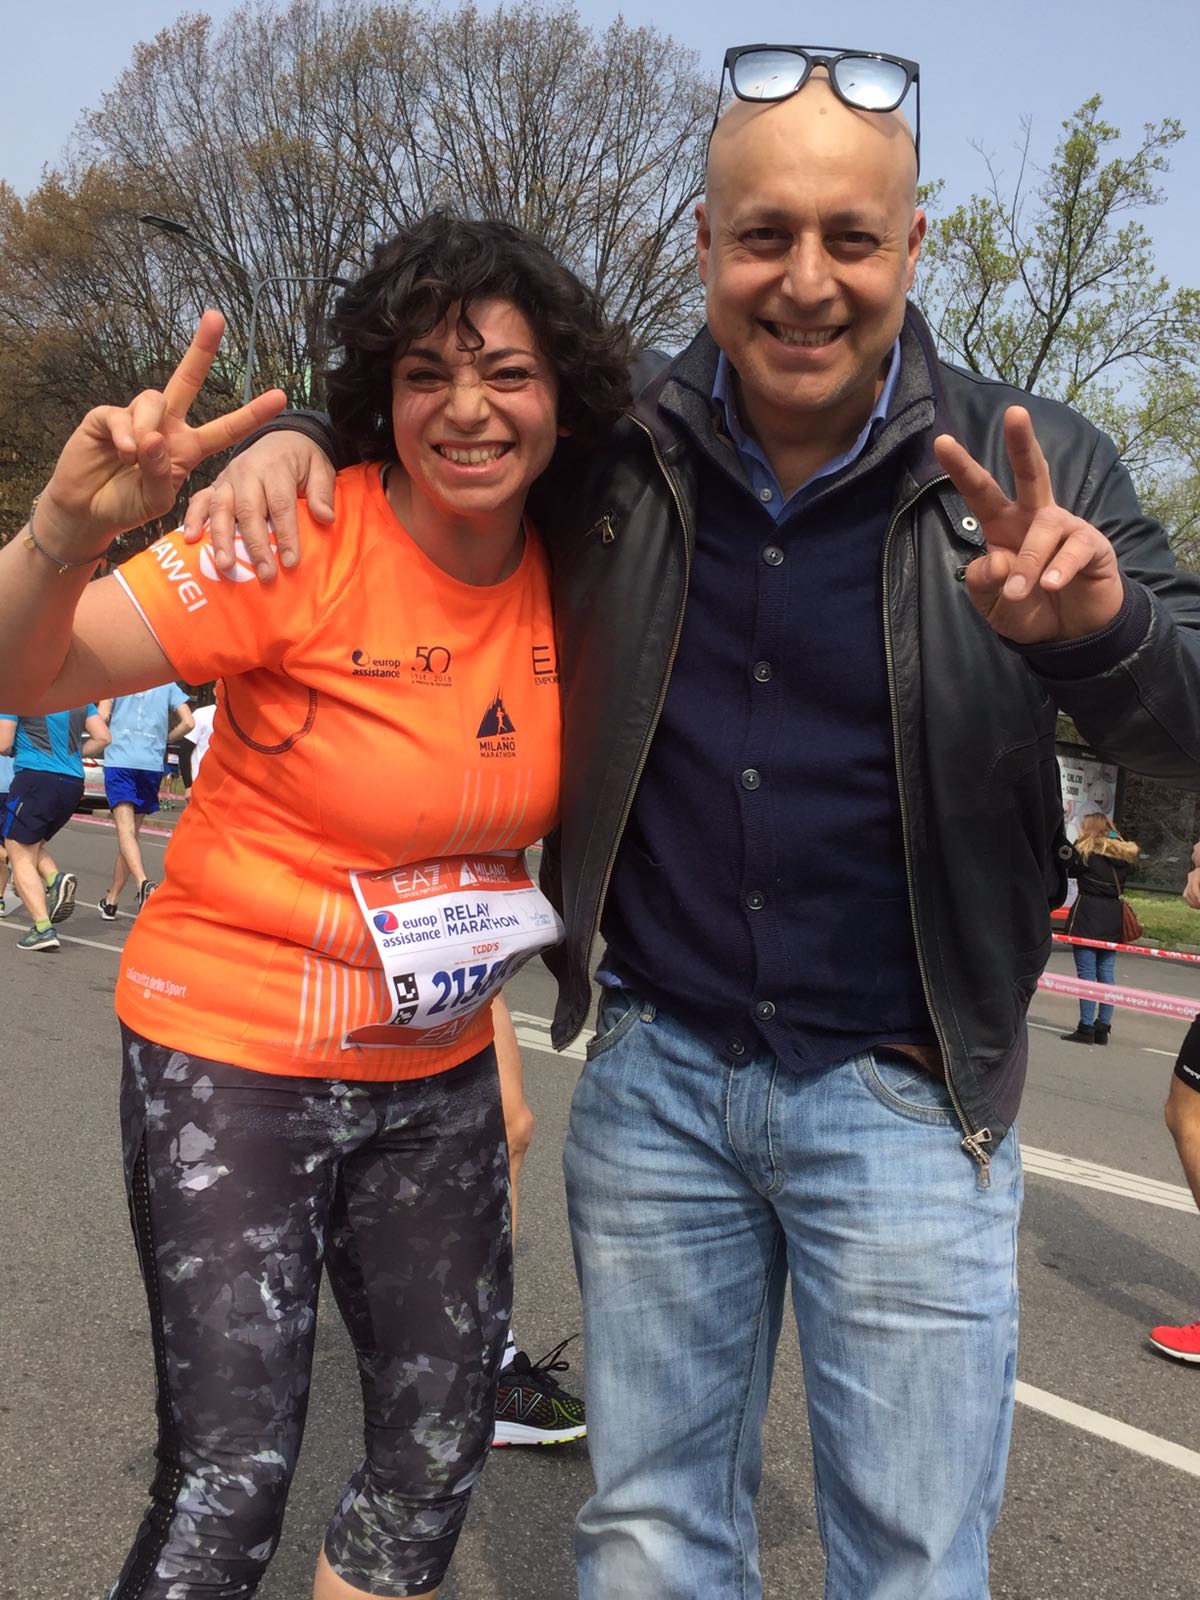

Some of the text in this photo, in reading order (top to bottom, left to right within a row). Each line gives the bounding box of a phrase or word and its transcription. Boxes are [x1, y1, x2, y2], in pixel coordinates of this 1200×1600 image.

[372, 659, 401, 669] europ
[411, 646, 451, 674] 50
[352, 668, 401, 678] assistance
[480, 741, 516, 751] MILANO
[473, 862, 506, 876] MILANO
[392, 864, 440, 893] EA7
[443, 903, 489, 922] RELAY
[402, 914, 438, 930] europ
[446, 915, 520, 936] MARATHON
[382, 929, 442, 948] assistance
[472, 942, 499, 955] TCDD'S
[165, 980, 187, 998] Sport
